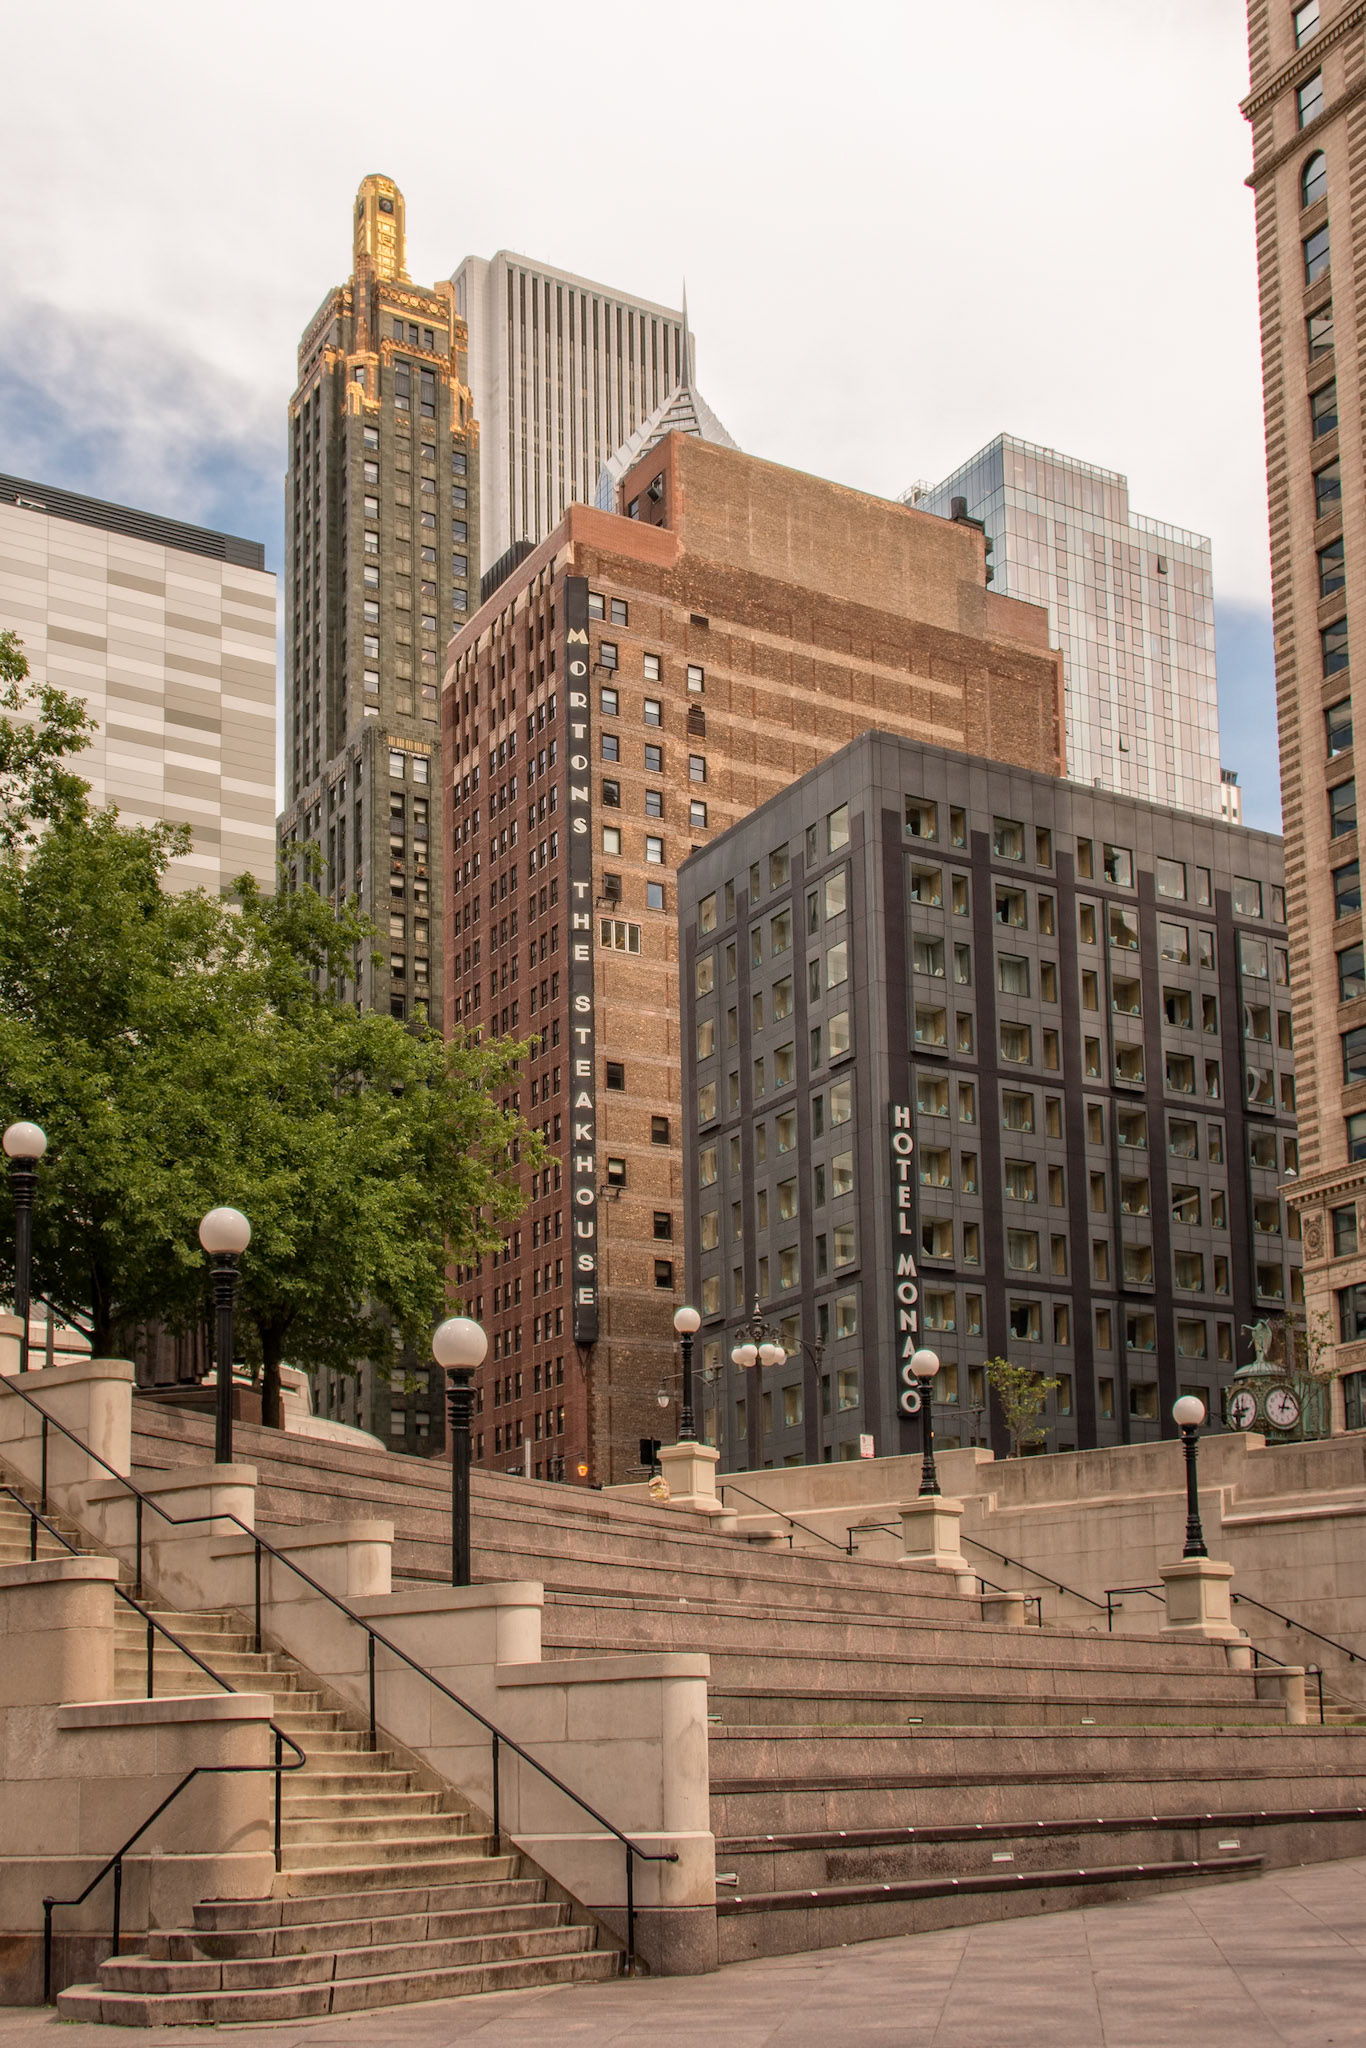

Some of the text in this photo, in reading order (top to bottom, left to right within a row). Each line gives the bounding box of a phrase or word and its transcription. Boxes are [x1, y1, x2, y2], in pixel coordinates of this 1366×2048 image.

[567, 628, 594, 1305] MORTONS THE STEAKHOUSE
[893, 1105, 921, 1414] HOTEL MONACO
